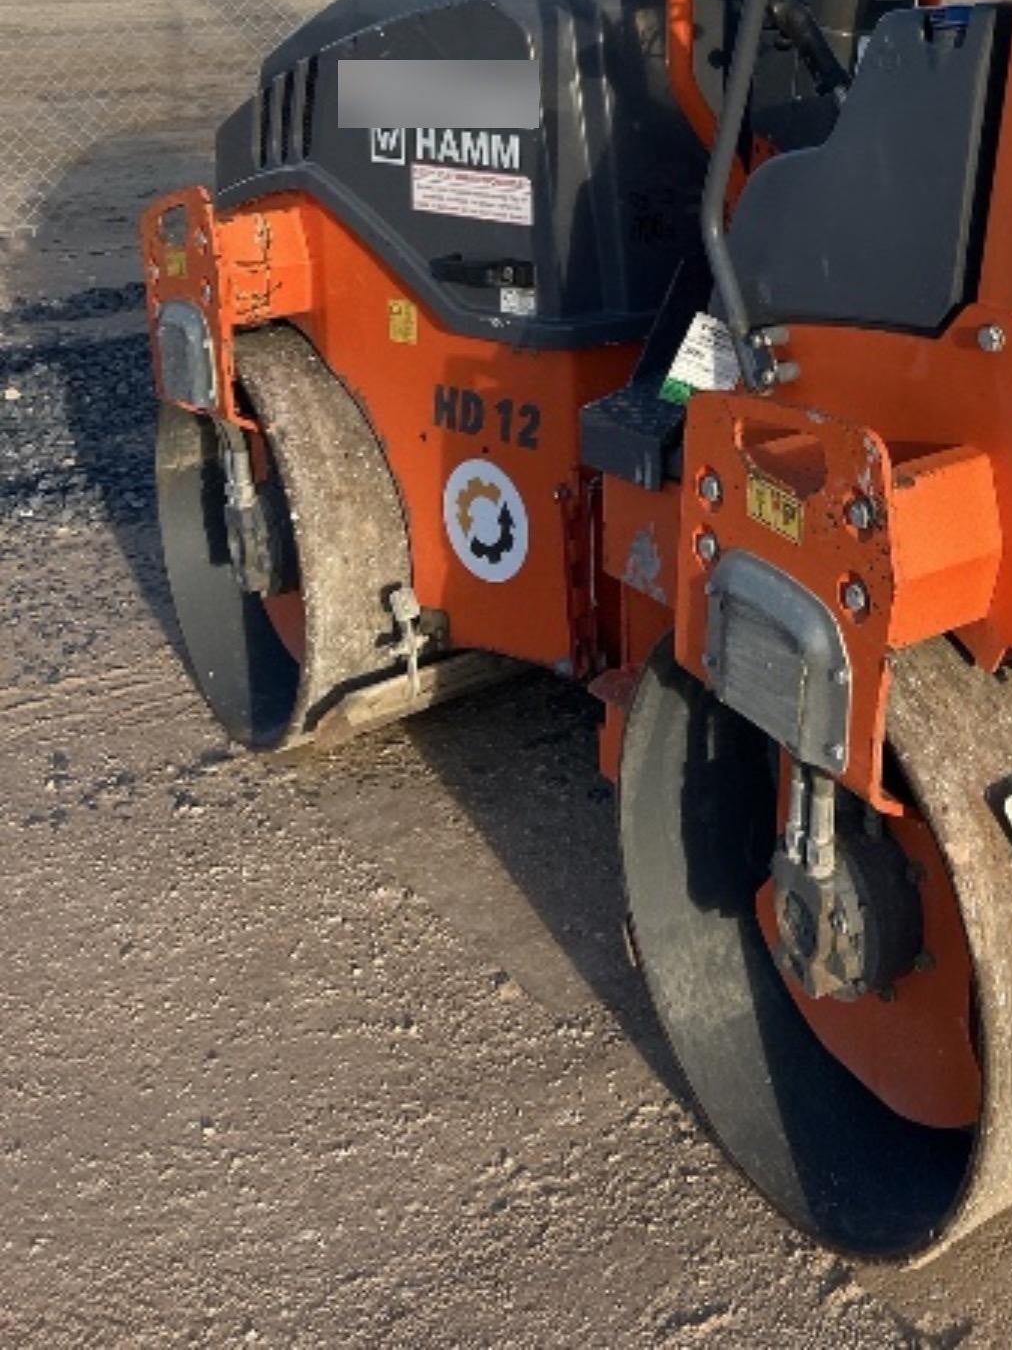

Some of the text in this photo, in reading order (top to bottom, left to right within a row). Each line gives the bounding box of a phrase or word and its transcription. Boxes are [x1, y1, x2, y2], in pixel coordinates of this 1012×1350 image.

[415, 127, 521, 170] HAMM
[433, 383, 541, 451] HD 12
